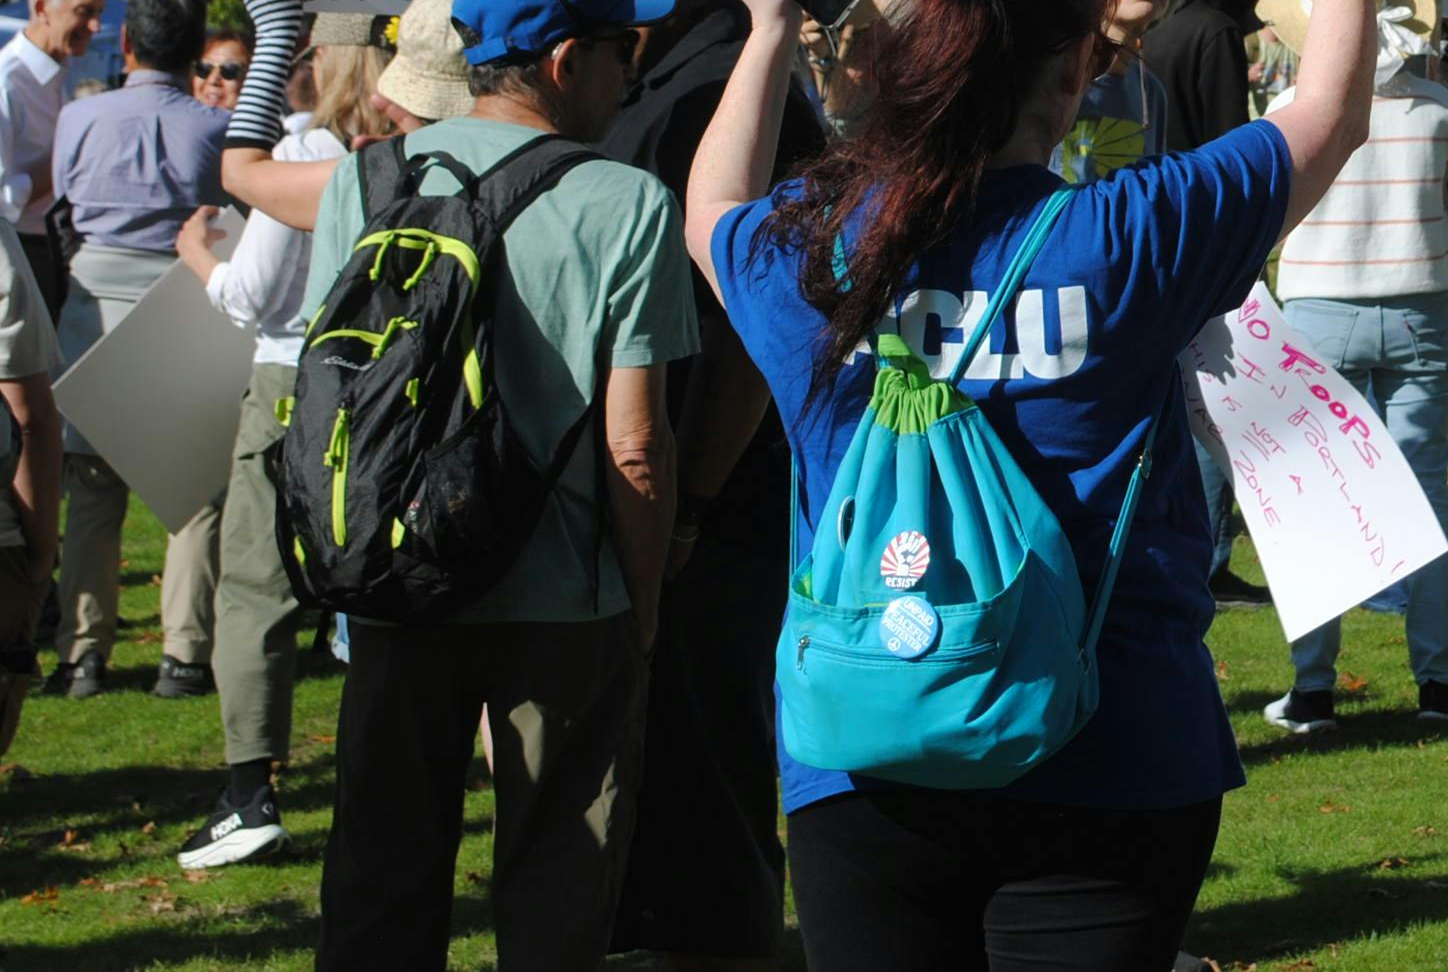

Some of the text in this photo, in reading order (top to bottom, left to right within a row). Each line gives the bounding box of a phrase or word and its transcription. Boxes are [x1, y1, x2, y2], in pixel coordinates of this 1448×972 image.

[1238, 298, 1271, 341] NO
[1250, 421, 1286, 455] NOT
[1233, 450, 1281, 527] ZONE
[884, 576, 917, 589] RESIST
